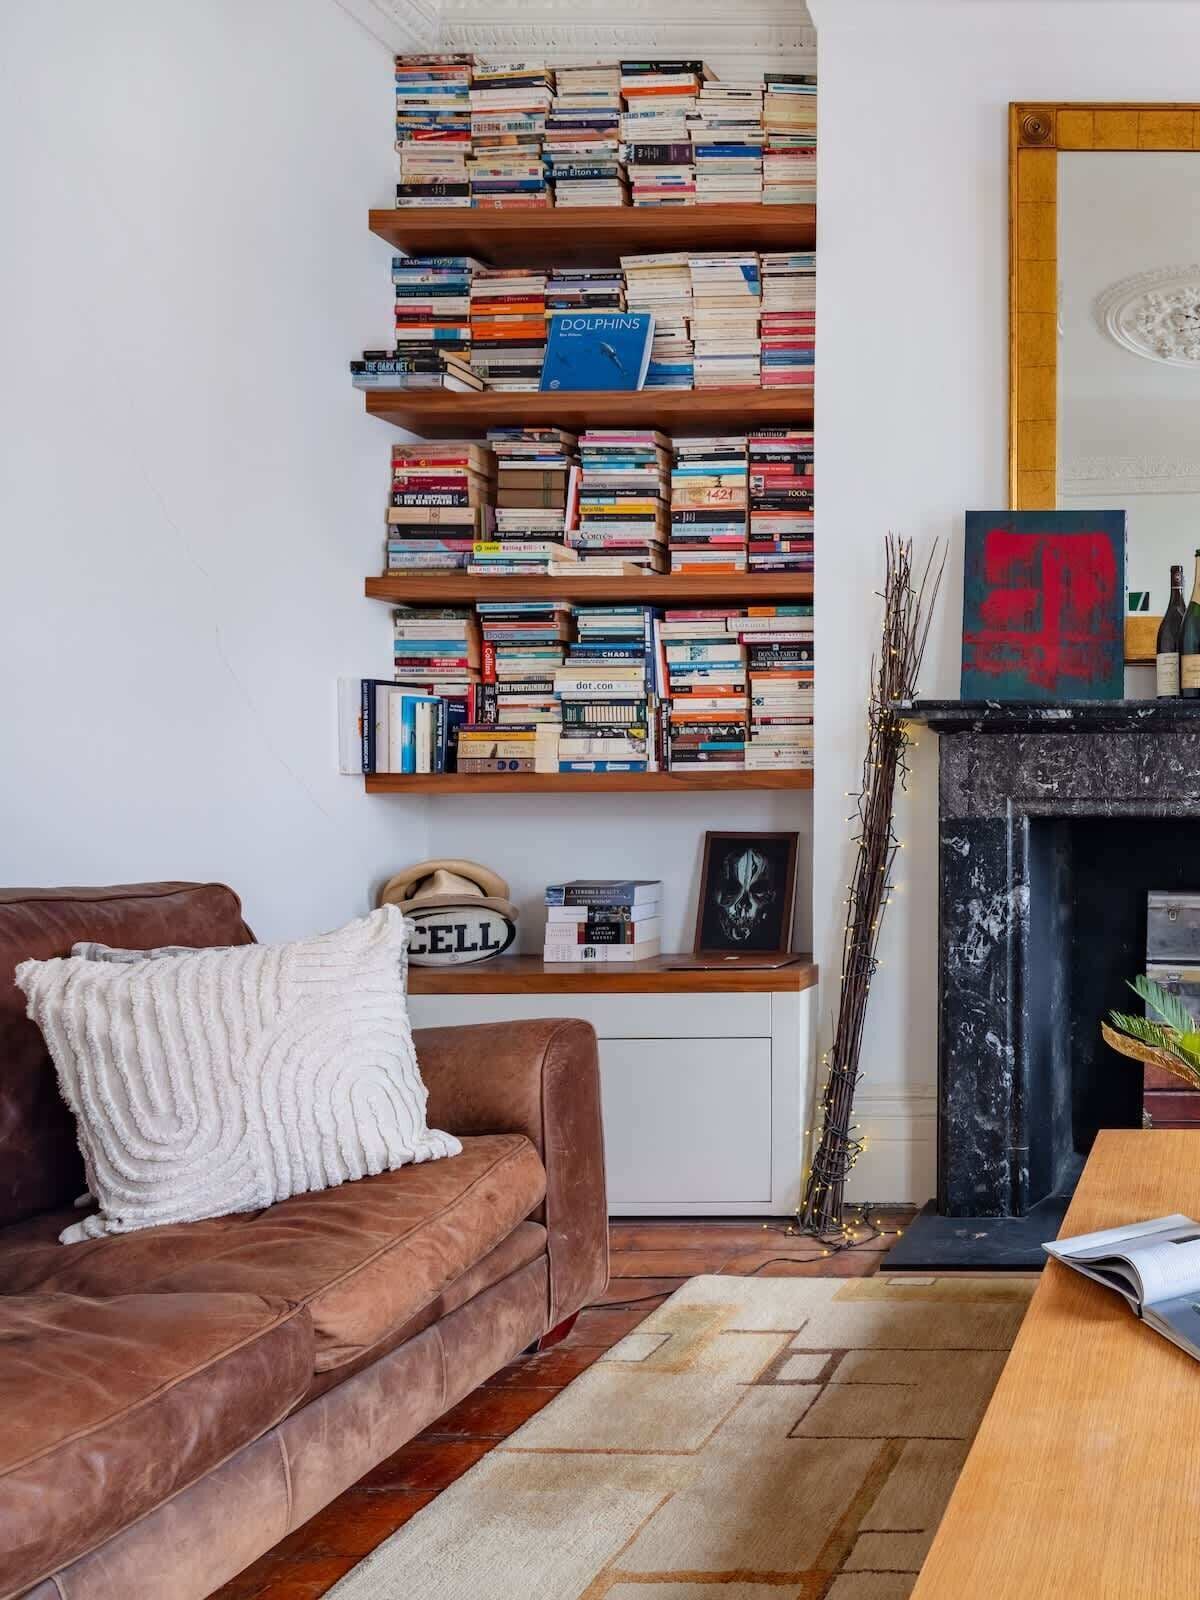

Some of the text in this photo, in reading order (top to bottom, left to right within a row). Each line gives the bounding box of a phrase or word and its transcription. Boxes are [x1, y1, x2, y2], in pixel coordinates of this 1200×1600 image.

[507, 121, 536, 131] MIDNIGHT
[570, 168, 591, 176] Elton
[560, 318, 640, 331] DOLPHINS
[365, 361, 408, 371] THE DARK NET
[707, 490, 732, 500] 1421
[484, 648, 492, 675] Collins
[500, 684, 509, 692] THE
[576, 682, 613, 690] dot.con
